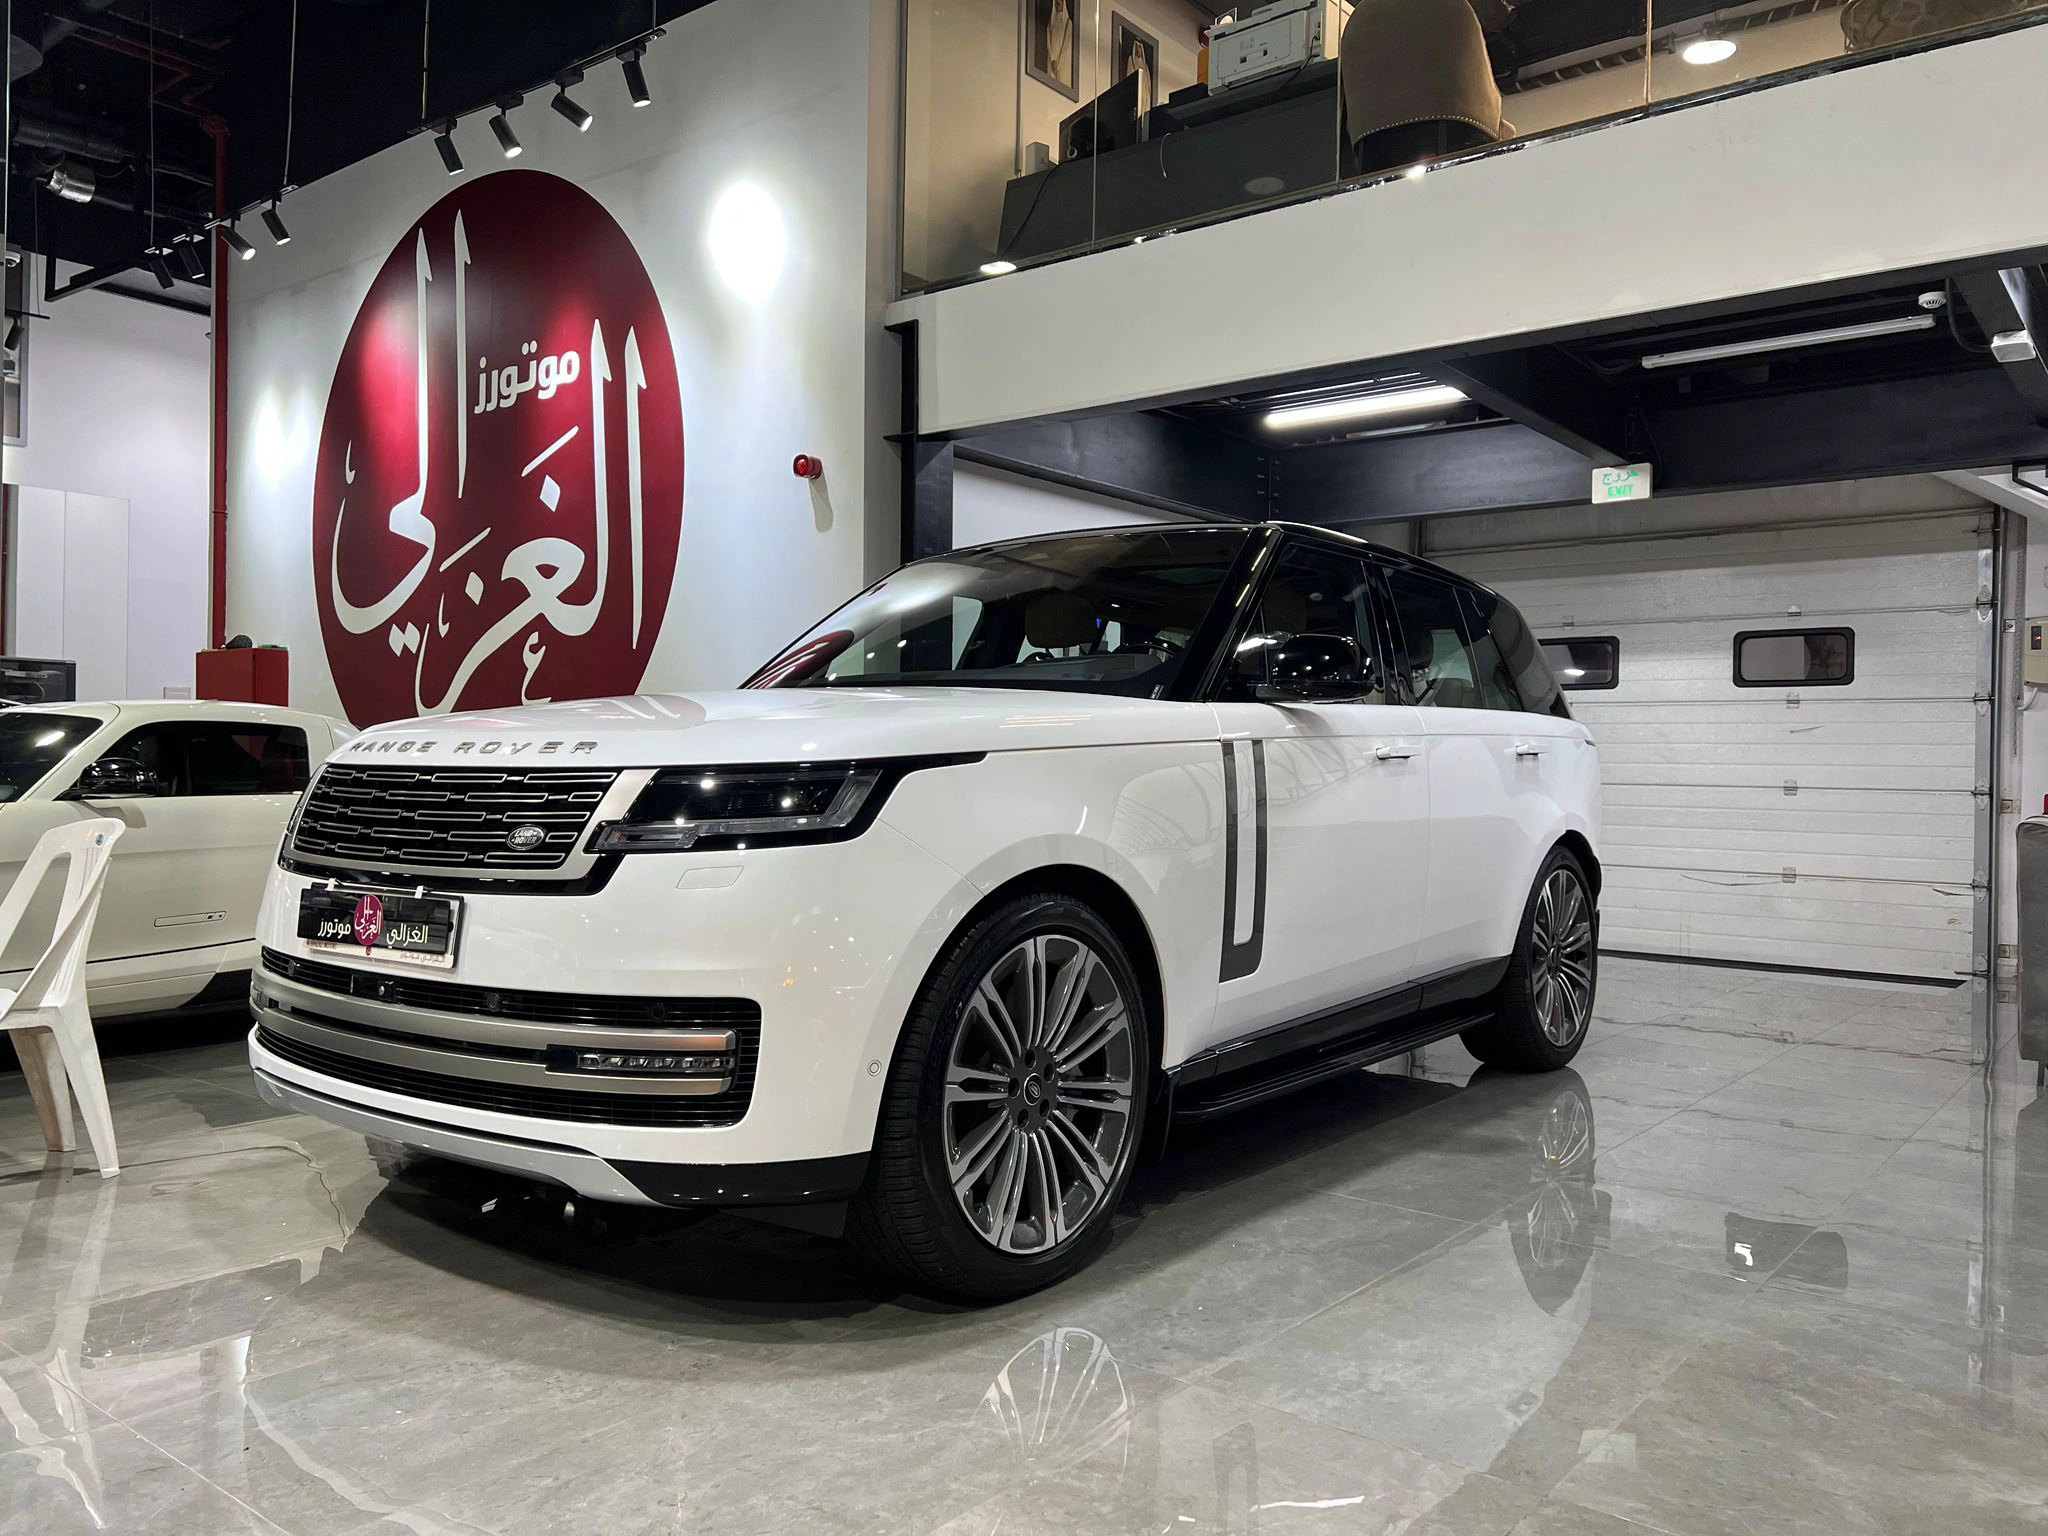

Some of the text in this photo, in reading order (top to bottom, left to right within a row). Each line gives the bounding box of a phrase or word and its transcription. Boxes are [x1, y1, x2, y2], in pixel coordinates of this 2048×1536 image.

[474, 340, 580, 414] موتورز
[1608, 484, 1634, 497] EXIT
[350, 741, 598, 755] RANGE ROVER
[514, 829, 537, 844] LAND ROVER
[317, 918, 429, 948] الغزالي موتورز
